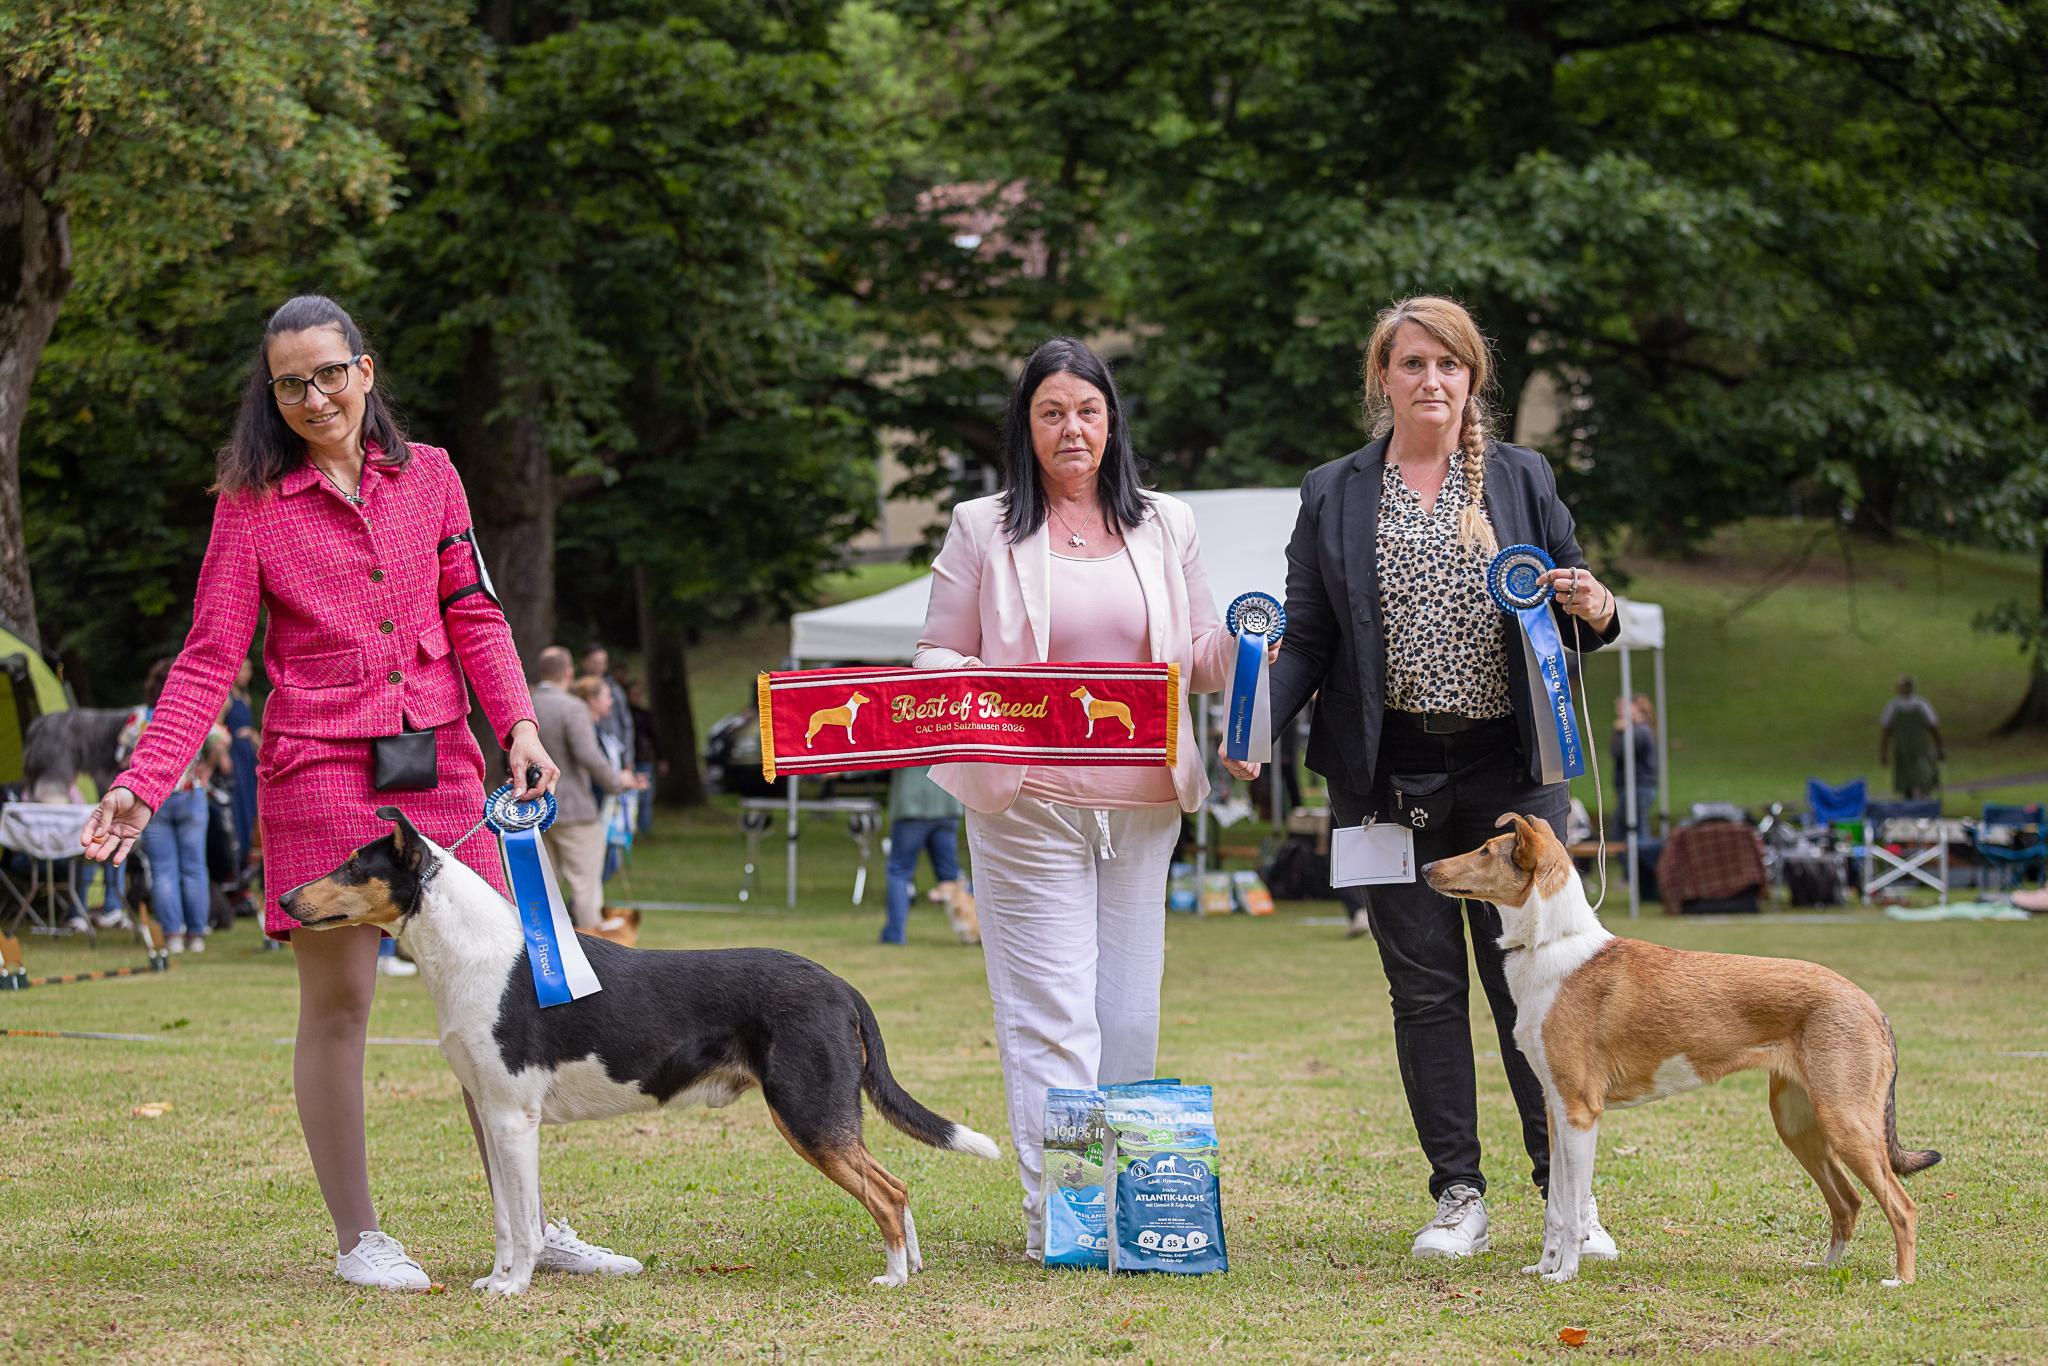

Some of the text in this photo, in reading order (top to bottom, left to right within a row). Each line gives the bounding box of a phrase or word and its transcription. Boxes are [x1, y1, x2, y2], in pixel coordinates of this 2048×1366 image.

[891, 691, 1049, 723] Best of Breed
[1546, 655, 1560, 680] Best
[1557, 695, 1573, 744] Opposite
[1568, 746, 1576, 767] Sex
[915, 722, 1025, 734] CAC Bad Salzhausen 2026
[534, 927, 547, 942] of
[538, 944, 555, 977] Breed
[1053, 1125, 1091, 1138] 100%
[1135, 1193, 1205, 1202] ATLANTIK-LACHS
[1143, 1236, 1154, 1244] 65
[1167, 1239, 1178, 1247] 35
